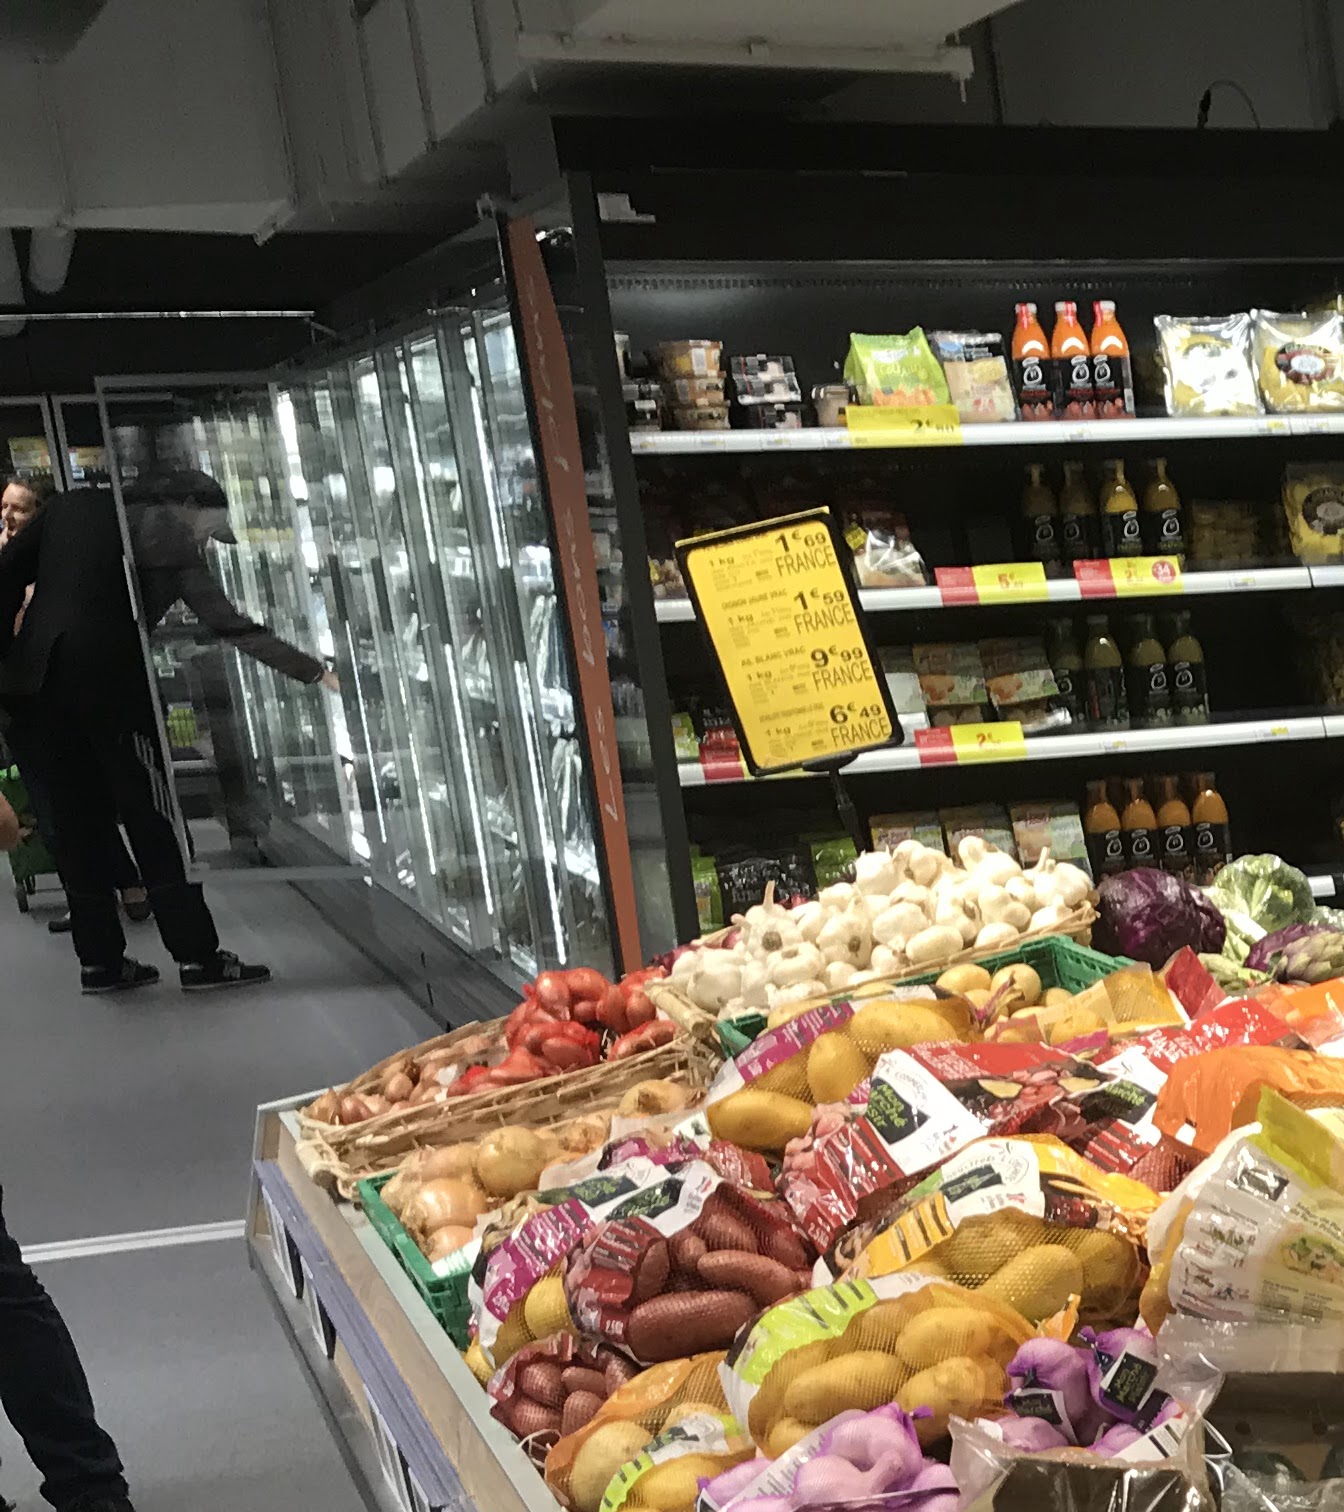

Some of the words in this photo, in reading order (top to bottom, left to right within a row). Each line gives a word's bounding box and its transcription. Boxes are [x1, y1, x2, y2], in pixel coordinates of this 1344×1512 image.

[775, 545, 836, 577] FRANCE
[794, 603, 855, 635] FRANCE
[812, 659, 873, 692] FRANCE
[831, 716, 893, 748] FRANCE
